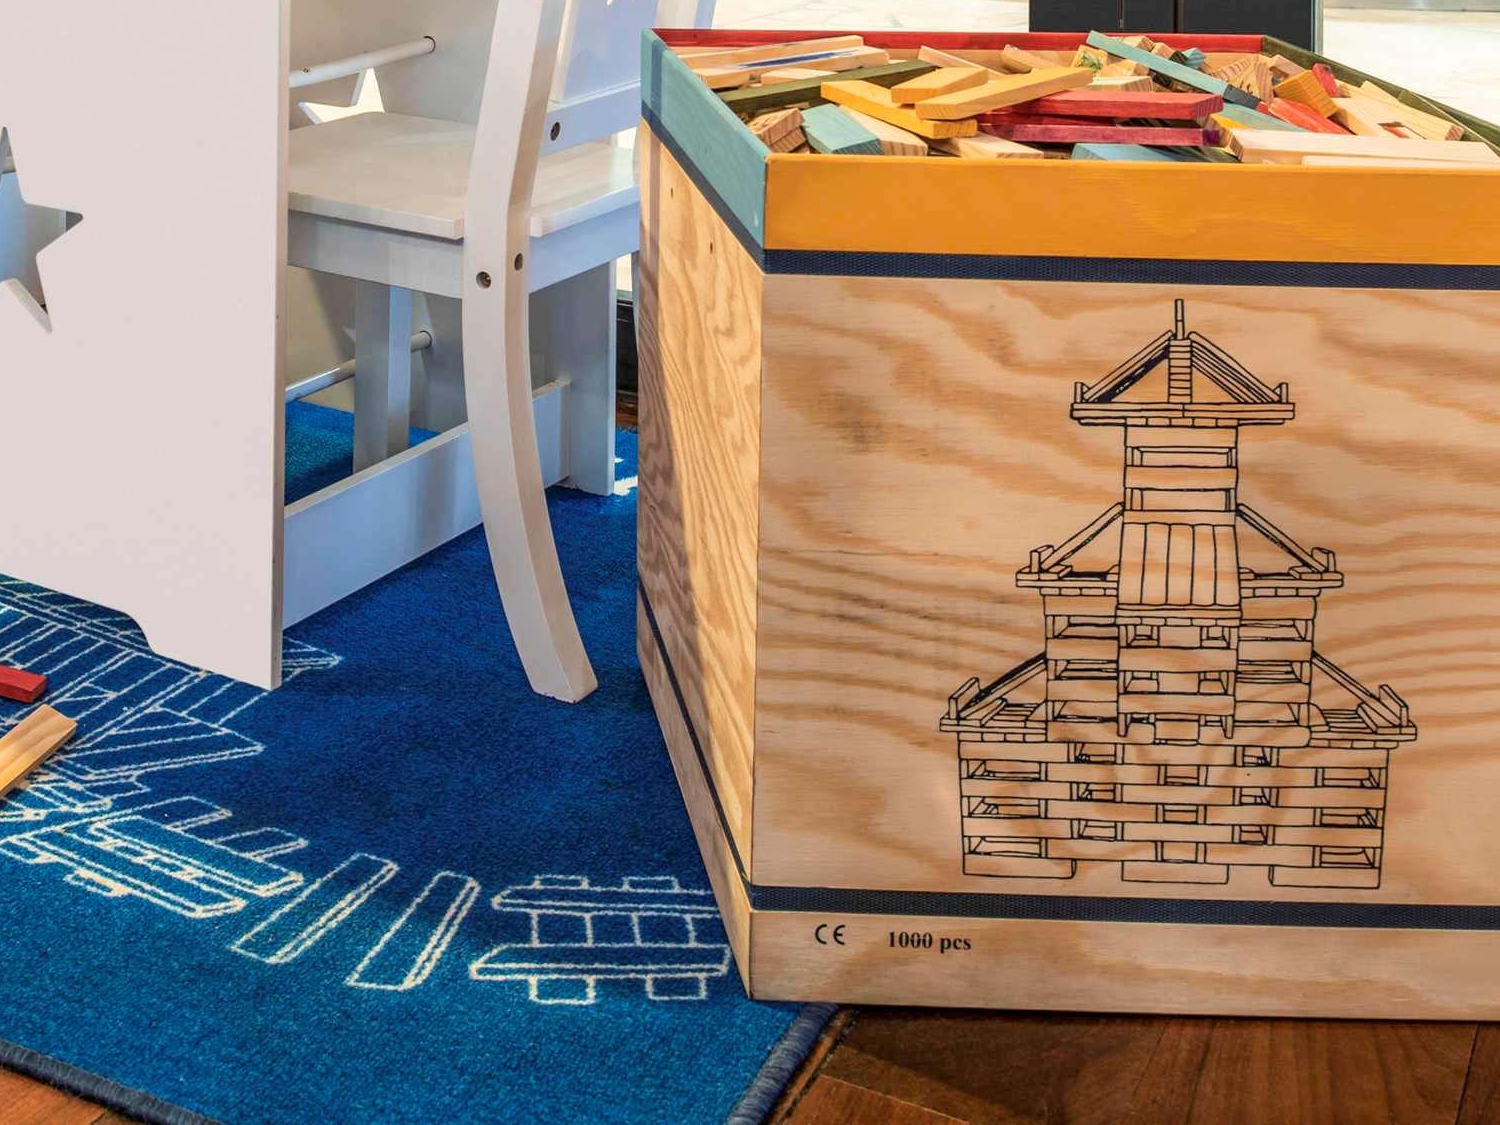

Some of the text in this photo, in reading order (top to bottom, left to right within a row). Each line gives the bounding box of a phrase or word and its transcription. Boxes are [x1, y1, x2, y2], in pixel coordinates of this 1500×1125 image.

[815, 923, 972, 954] CE 1000 pcs
